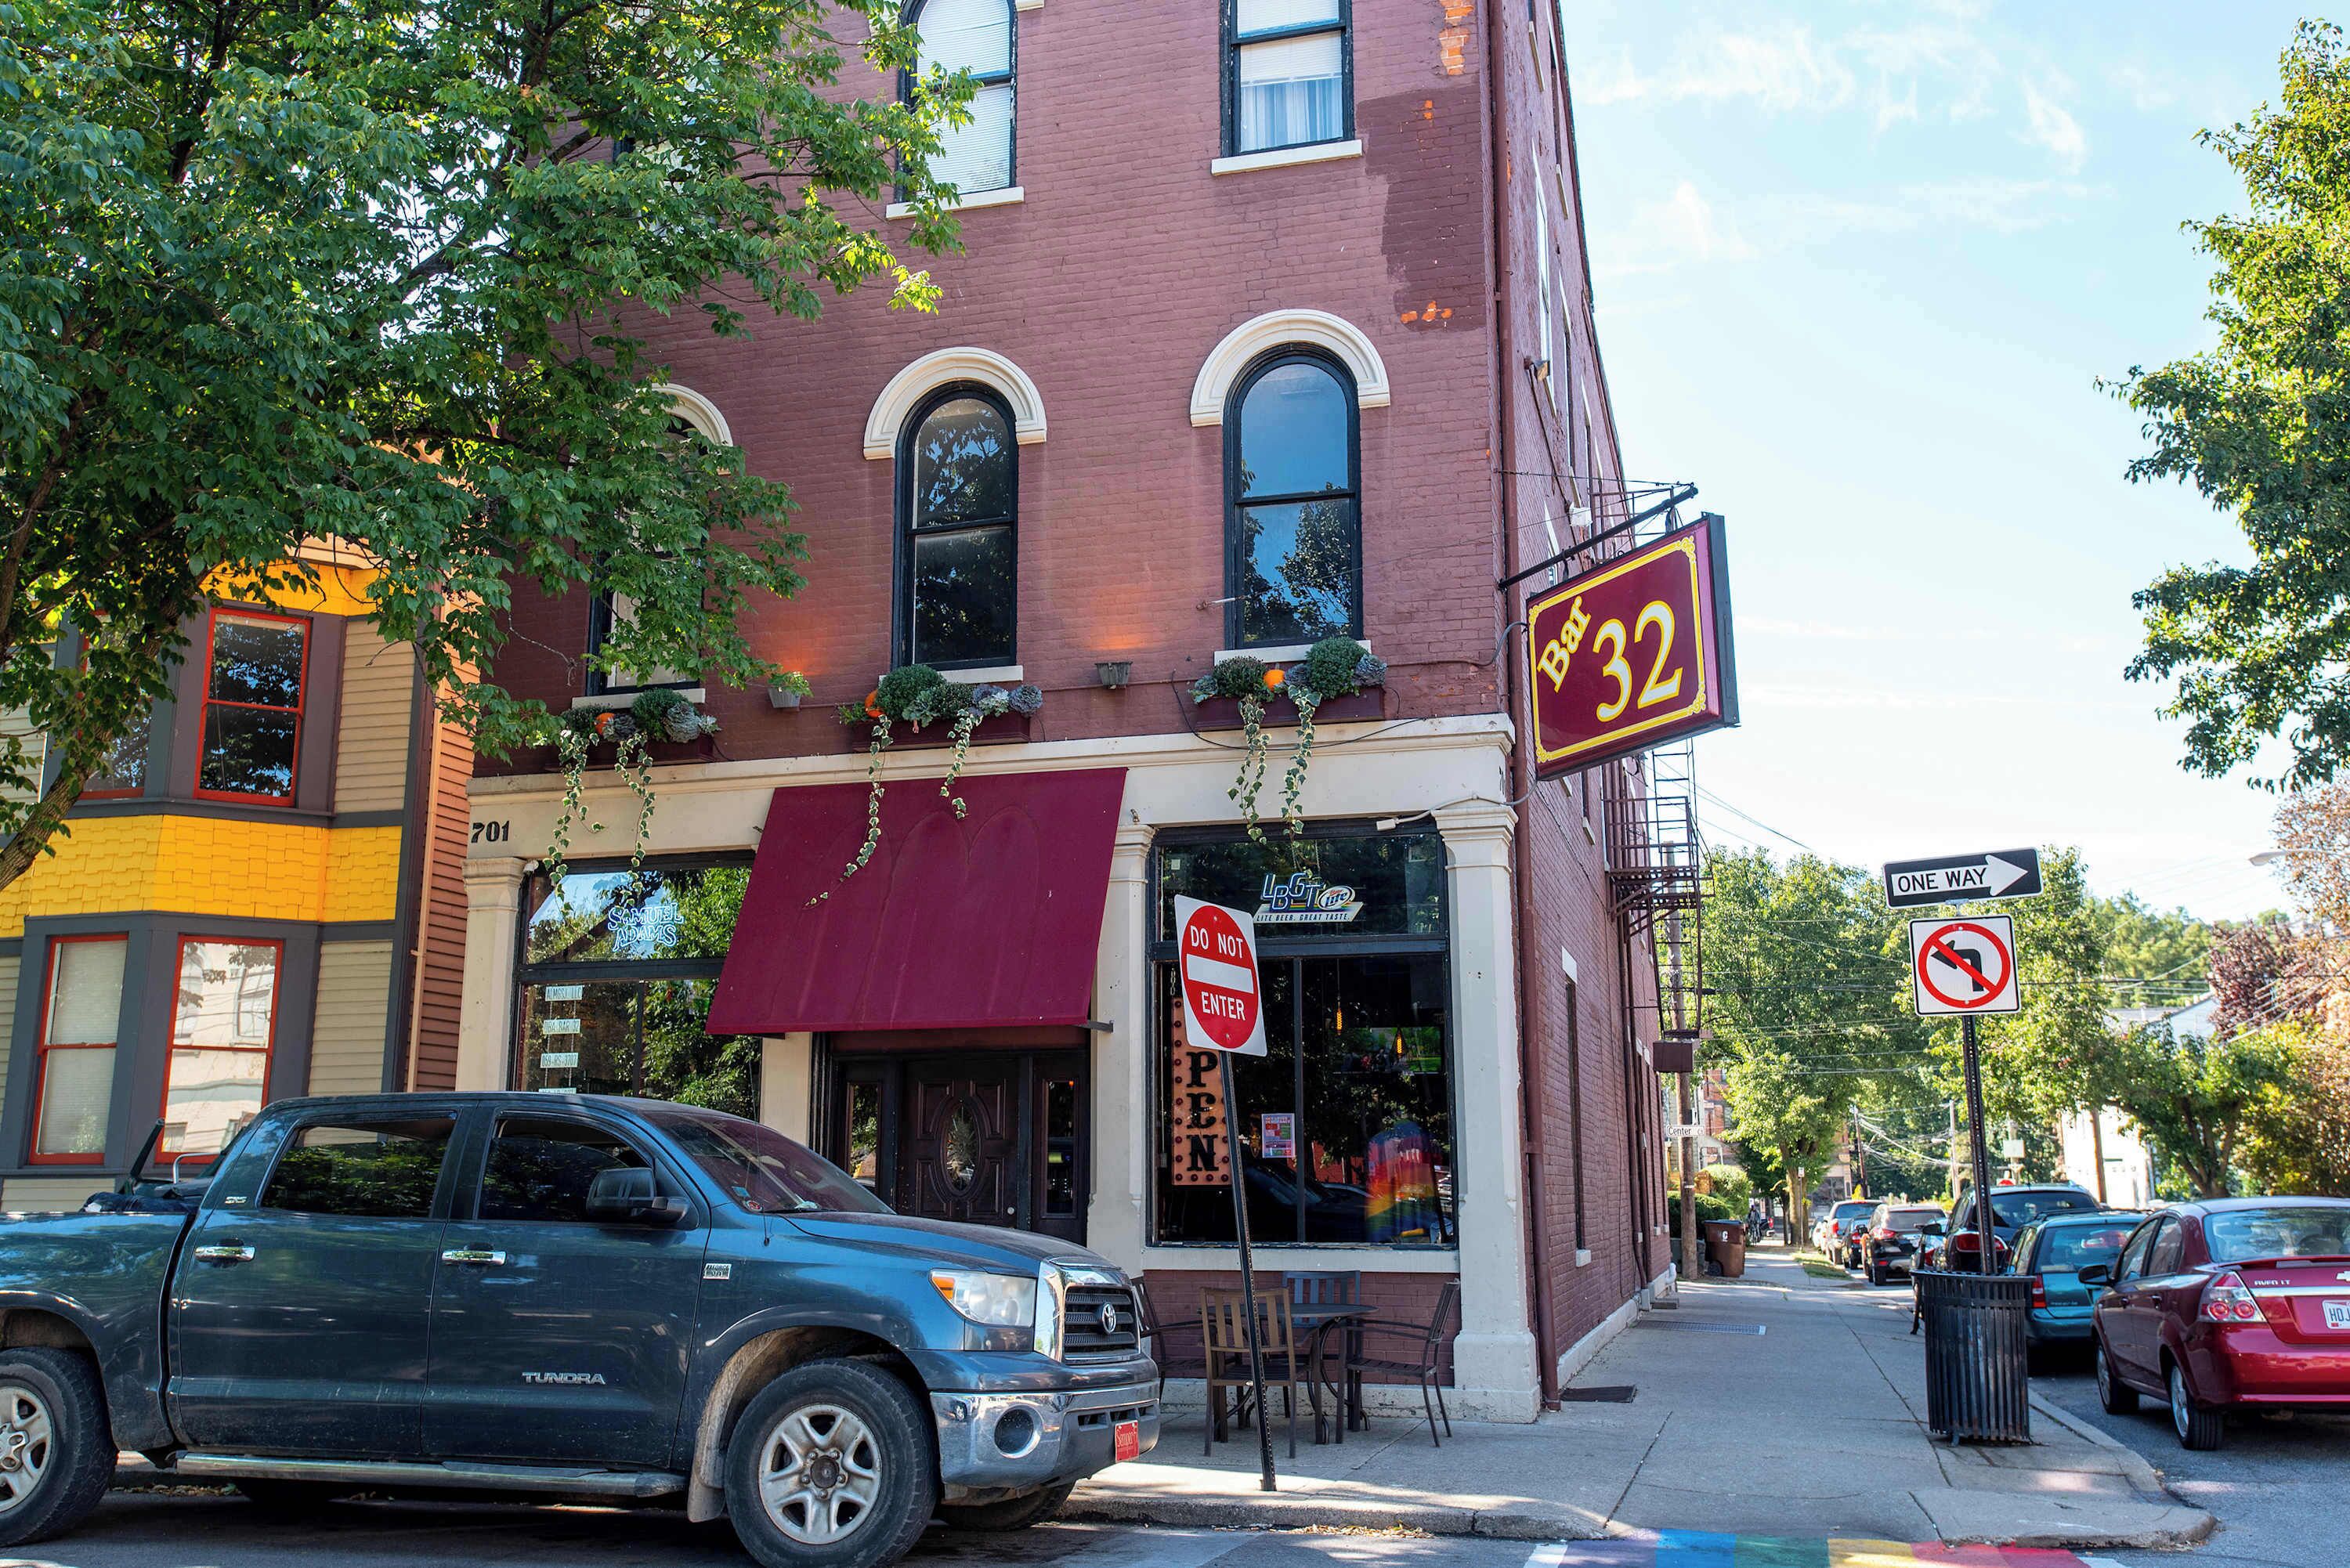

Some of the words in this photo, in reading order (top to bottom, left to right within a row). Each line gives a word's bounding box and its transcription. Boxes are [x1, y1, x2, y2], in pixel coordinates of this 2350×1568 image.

[1537, 595, 1591, 693] Bar
[1593, 600, 1683, 722] 32
[471, 820, 509, 843] 701
[1897, 873, 1939, 893] ONE
[1945, 867, 1987, 887] WAY
[608, 902, 685, 930] SAMUEL
[613, 924, 677, 952] ADAMS
[1190, 925, 1209, 950] DO
[1217, 932, 1244, 959] NOT
[1201, 991, 1246, 1021] ENTER
[559, 1021, 570, 1032] BAR
[573, 1020, 580, 1031] 32
[1186, 1051, 1219, 1172] PEN
[1668, 1127, 1691, 1136] Center
[522, 1372, 606, 1385] TUNDRA
